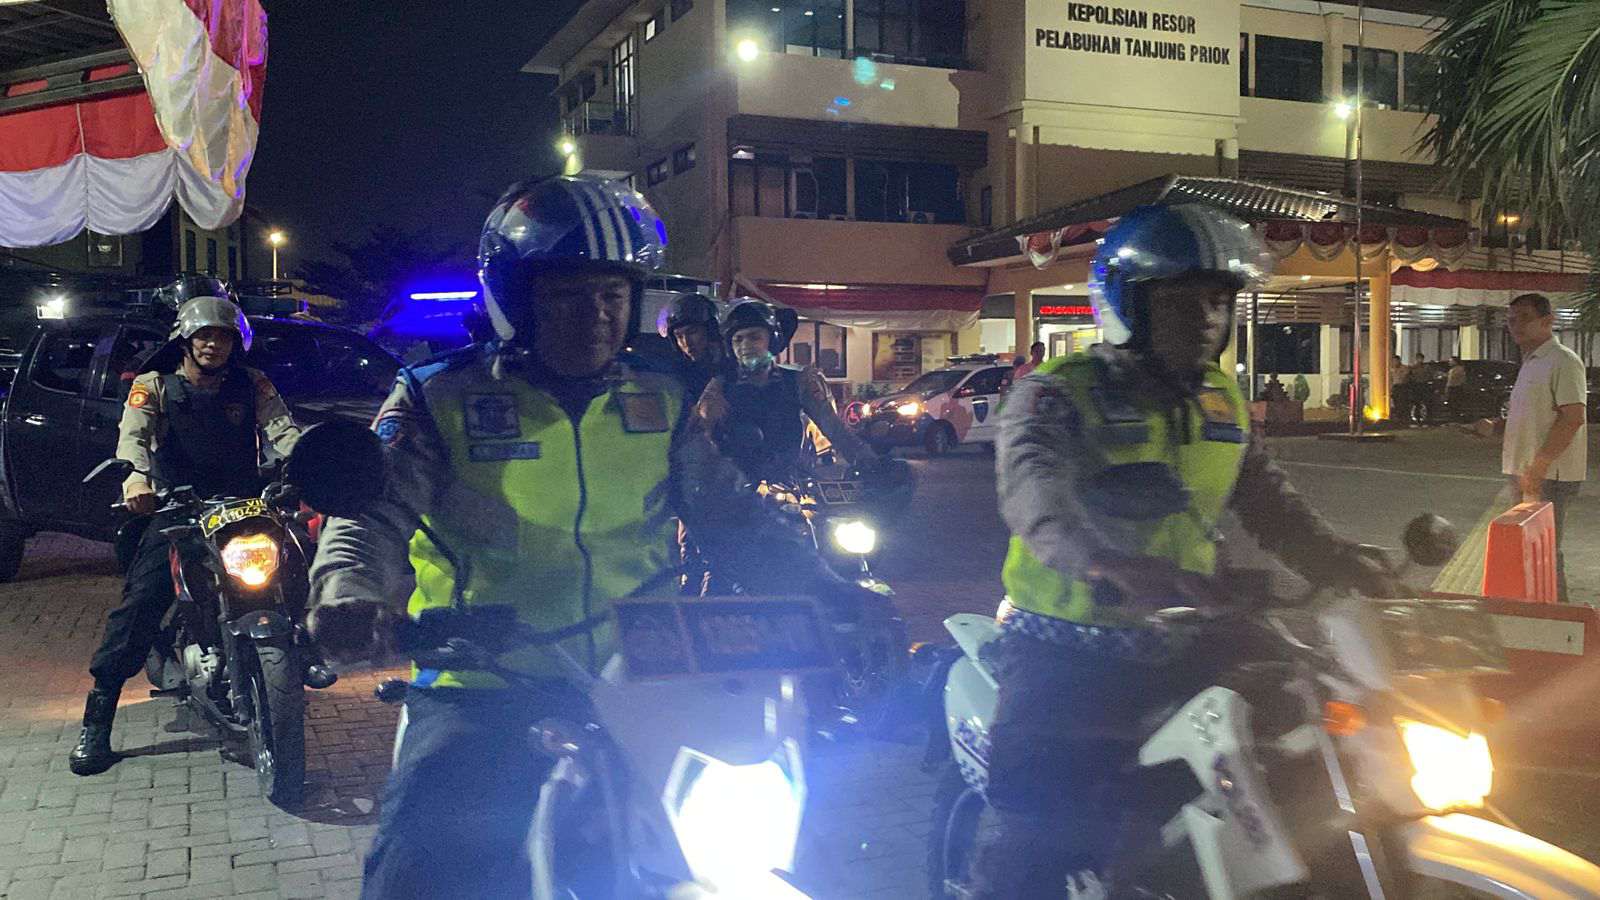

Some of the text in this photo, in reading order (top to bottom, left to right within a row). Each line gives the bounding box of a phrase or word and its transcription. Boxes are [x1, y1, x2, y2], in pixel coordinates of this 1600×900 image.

[1067, 2, 1196, 34] KEPOLISIAN RESOR
[1035, 28, 1230, 65] PELABUHAN TANJUNG PRIOK
